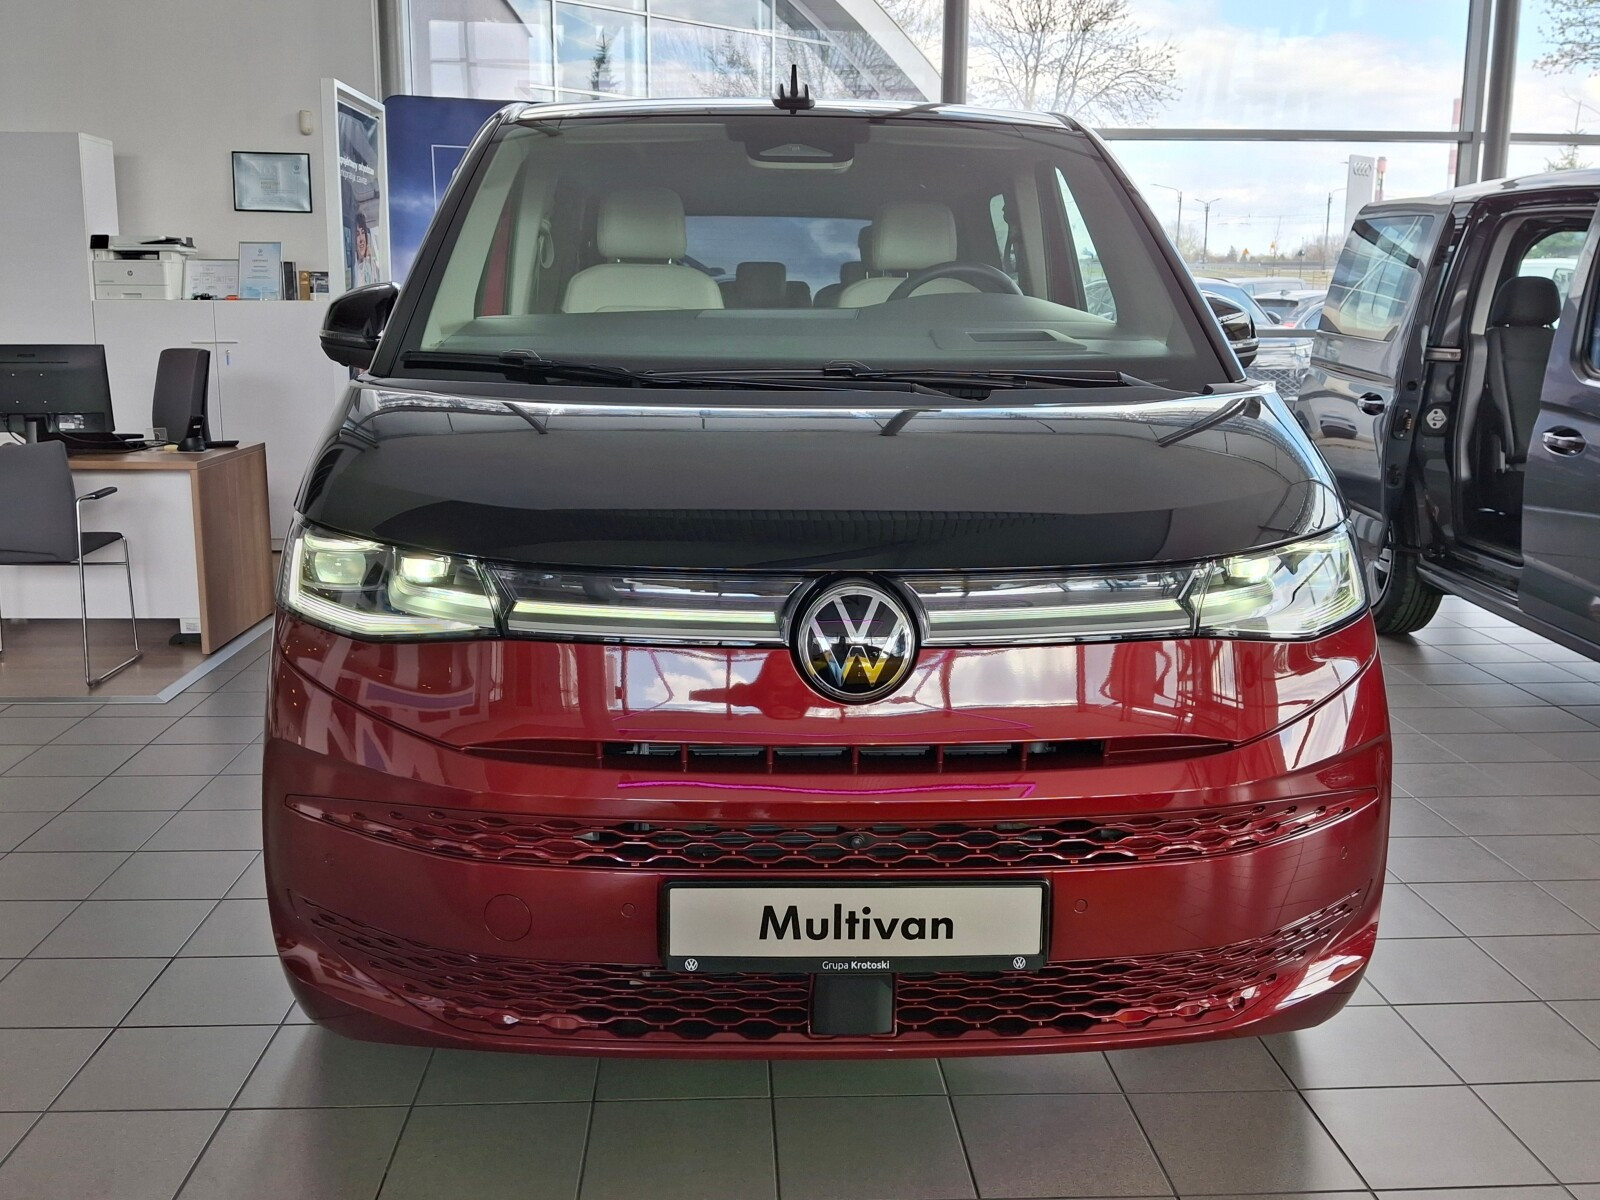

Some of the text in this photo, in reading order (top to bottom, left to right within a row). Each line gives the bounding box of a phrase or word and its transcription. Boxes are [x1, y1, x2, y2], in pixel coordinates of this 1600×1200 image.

[758, 903, 954, 941] Multivan
[822, 960, 890, 971] Grupa Krotoski
